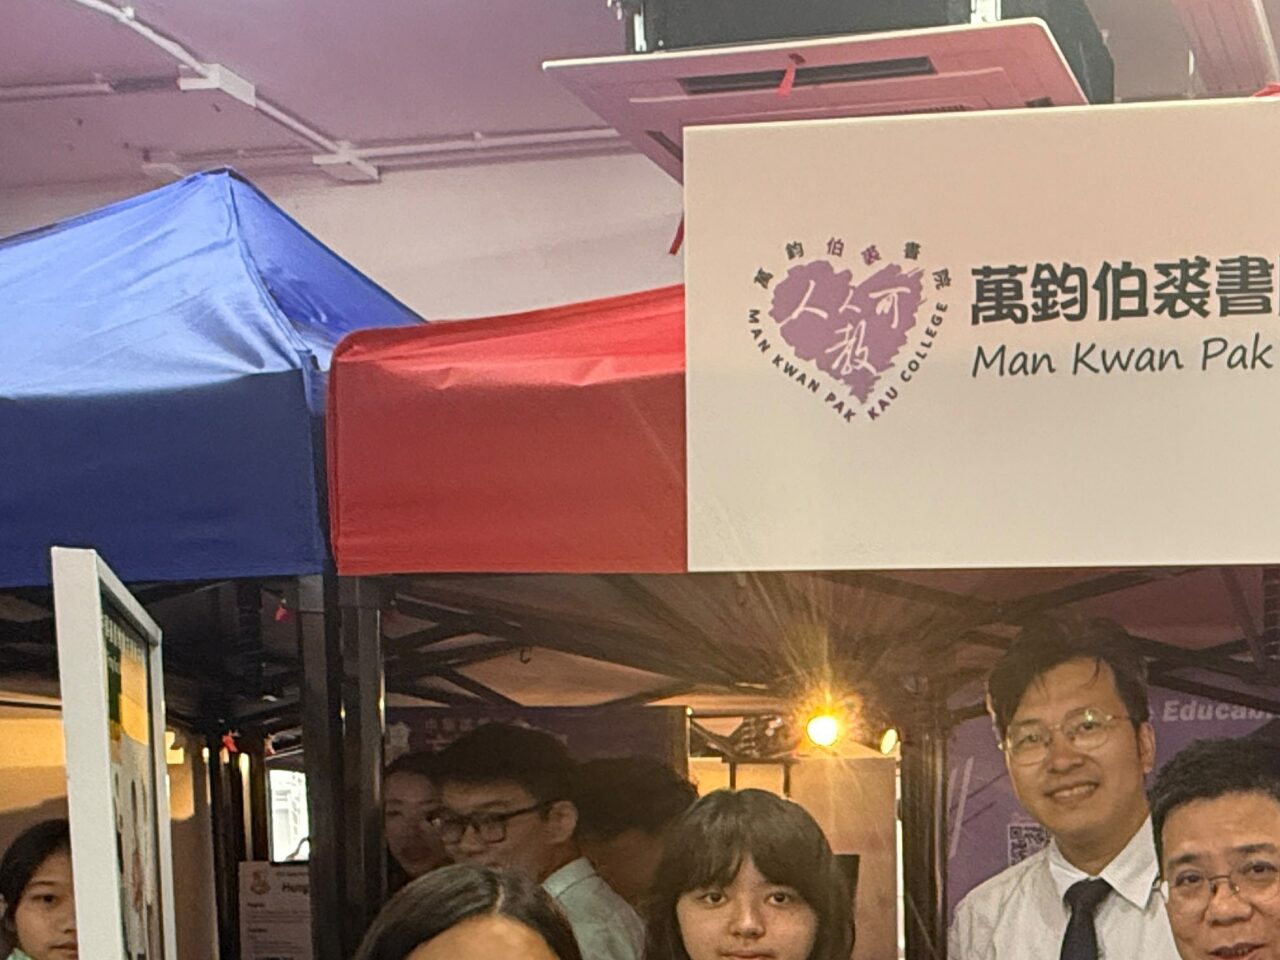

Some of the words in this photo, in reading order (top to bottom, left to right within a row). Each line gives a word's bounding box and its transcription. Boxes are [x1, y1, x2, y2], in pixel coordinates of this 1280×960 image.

[748, 308, 772, 354] MAN
[772, 353, 820, 393] KWAN
[824, 391, 856, 423] PAK
[867, 386, 899, 421] KAU
[900, 302, 948, 383] COLLEGE
[971, 343, 1057, 378] Man
[1072, 341, 1184, 374] Kwan
[1201, 336, 1274, 372] Pak
